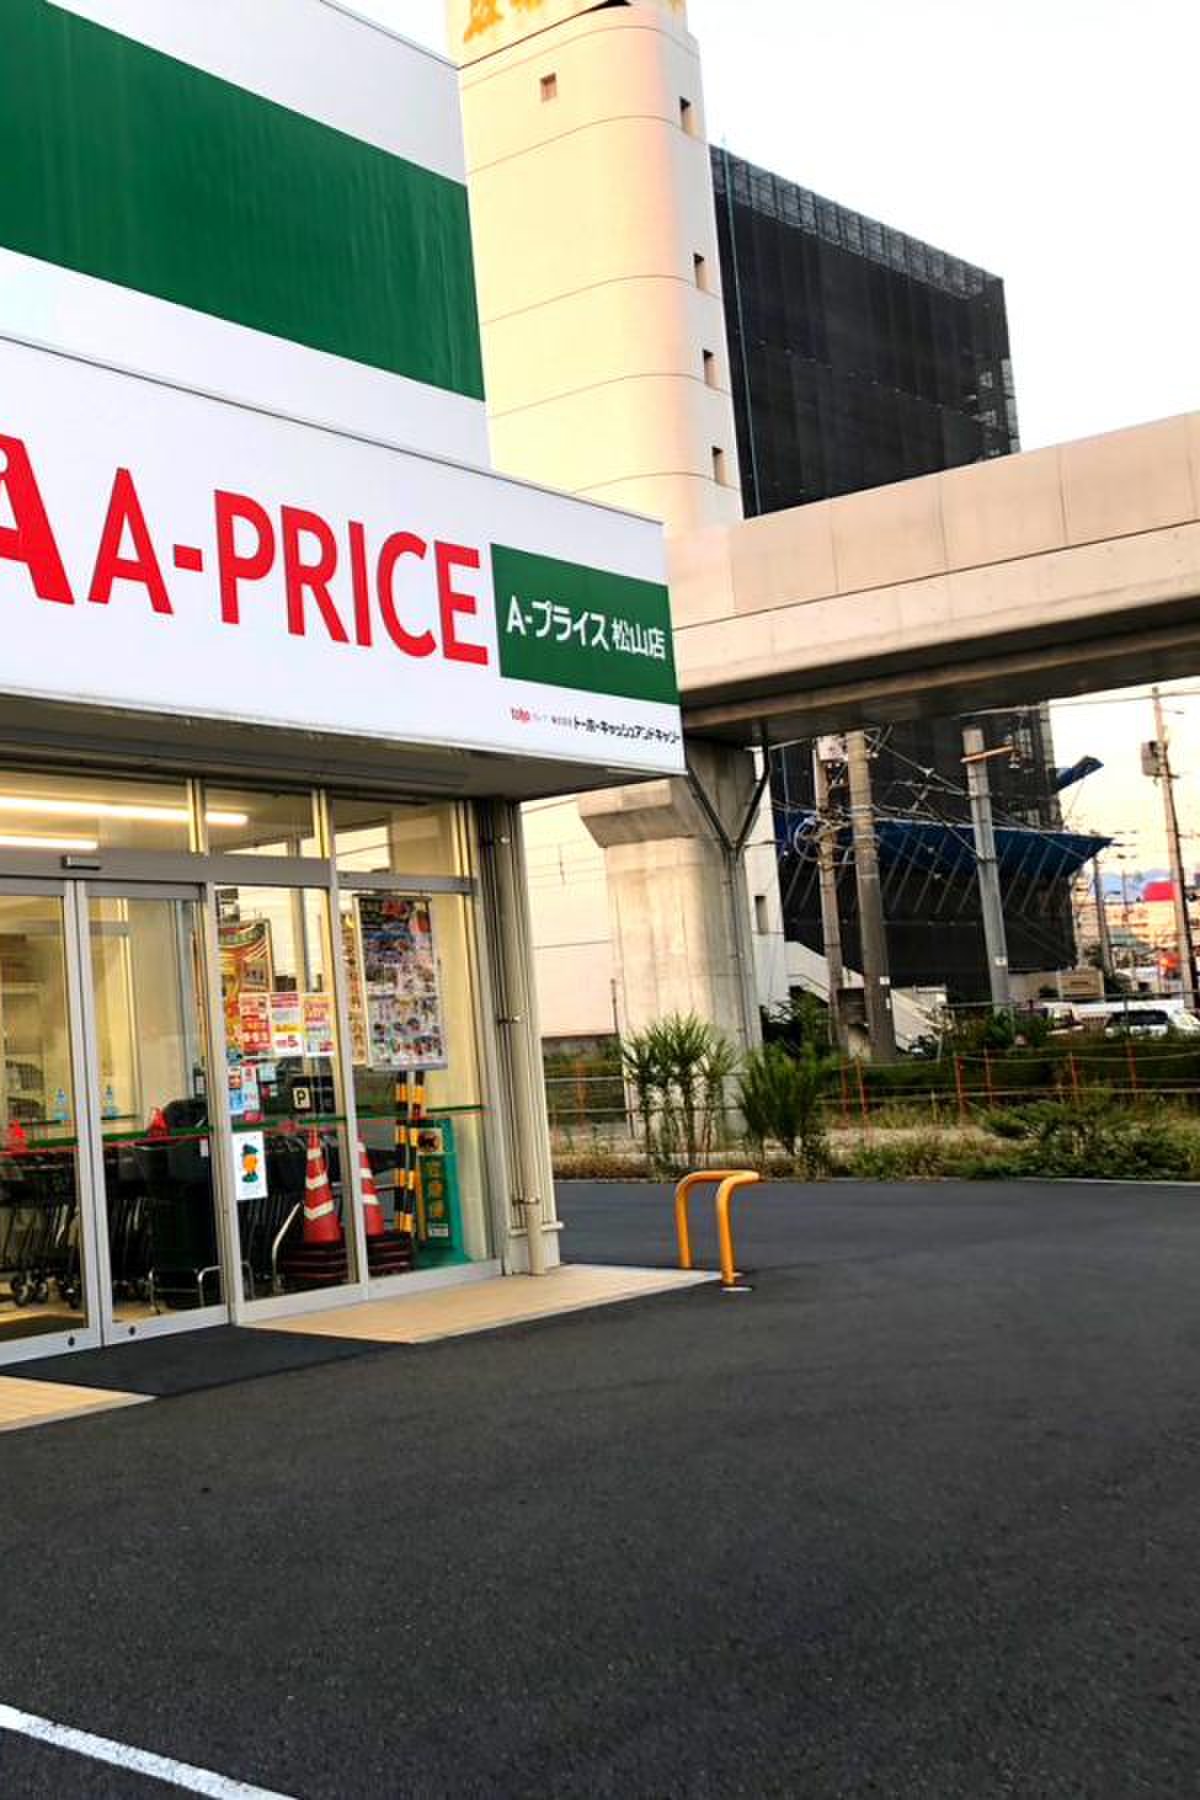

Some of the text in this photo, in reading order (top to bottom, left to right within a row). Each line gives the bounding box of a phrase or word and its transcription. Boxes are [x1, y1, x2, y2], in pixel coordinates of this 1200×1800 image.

[88, 467, 490, 666] A-PRICE
[506, 594, 666, 661] A-プライス 松山店
